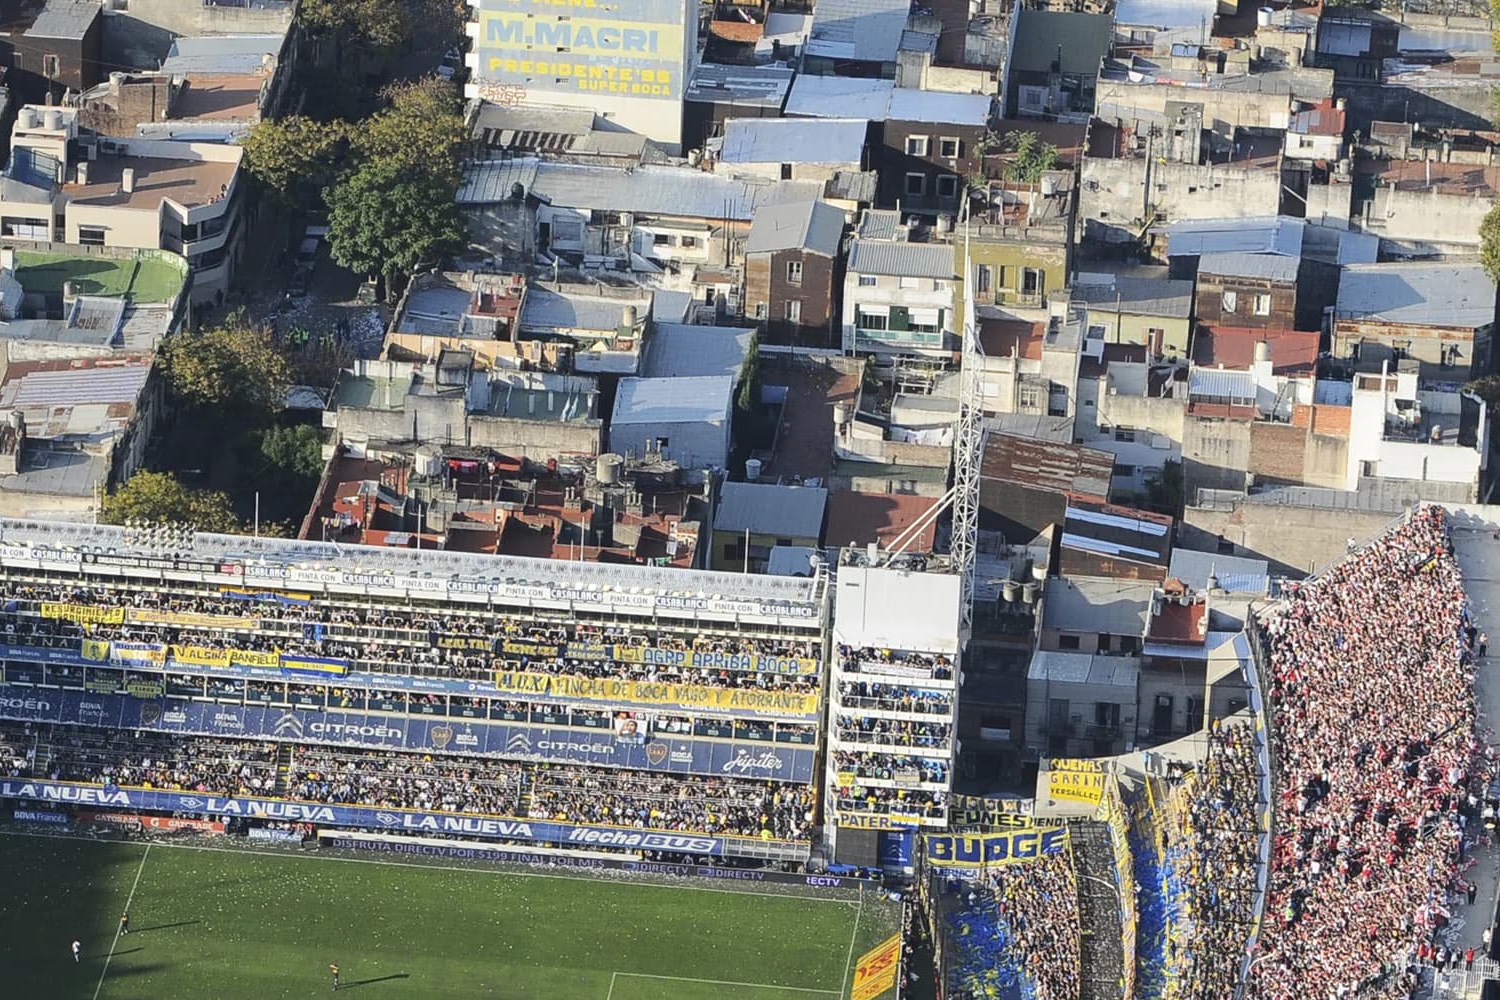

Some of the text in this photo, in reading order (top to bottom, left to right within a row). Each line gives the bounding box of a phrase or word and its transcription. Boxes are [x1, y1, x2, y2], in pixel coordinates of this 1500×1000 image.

[579, 80, 671, 96] SUPER BOCA
[10, 548, 24, 557] CON
[31, 550, 82, 562] CASABLANCA
[245, 566, 291, 579] ASABLANCA
[298, 572, 336, 582] PINTA CON
[343, 574, 395, 586] CASABLANCA
[402, 580, 439, 590] PINTA CON
[448, 581, 498, 592] CASABLANCA
[505, 586, 543, 597] PINTA CON
[551, 589, 602, 601] CASABLANCA
[610, 595, 648, 605] PINTA CON
[656, 596, 708, 609] CASABLANCA
[715, 602, 752, 612] PINTA CON
[760, 605, 812, 617] CASABLANCA
[231, 652, 278, 665] BANFIELD
[756, 659, 799, 674] BOCA
[636, 686, 668, 700] BOCA
[675, 687, 708, 702] VAGO
[730, 691, 806, 710] ATORRANTE
[310, 721, 402, 739] CITROËN
[538, 740, 615, 754] CITROËN
[2, 783, 132, 805] LA NUEVA
[206, 799, 336, 821] LA NUEVA
[951, 810, 1029, 828] FUNES
[403, 815, 533, 837] LA NUEVA
[568, 828, 713, 851] flecha BUS
[928, 829, 1067, 863] BUDGE
[333, 839, 605, 868] DISFRUTA DIRECTV POR $199 FINAL POR MES
[641, 864, 689, 874] DIRECTV
[715, 870, 765, 880] DIRECTV
